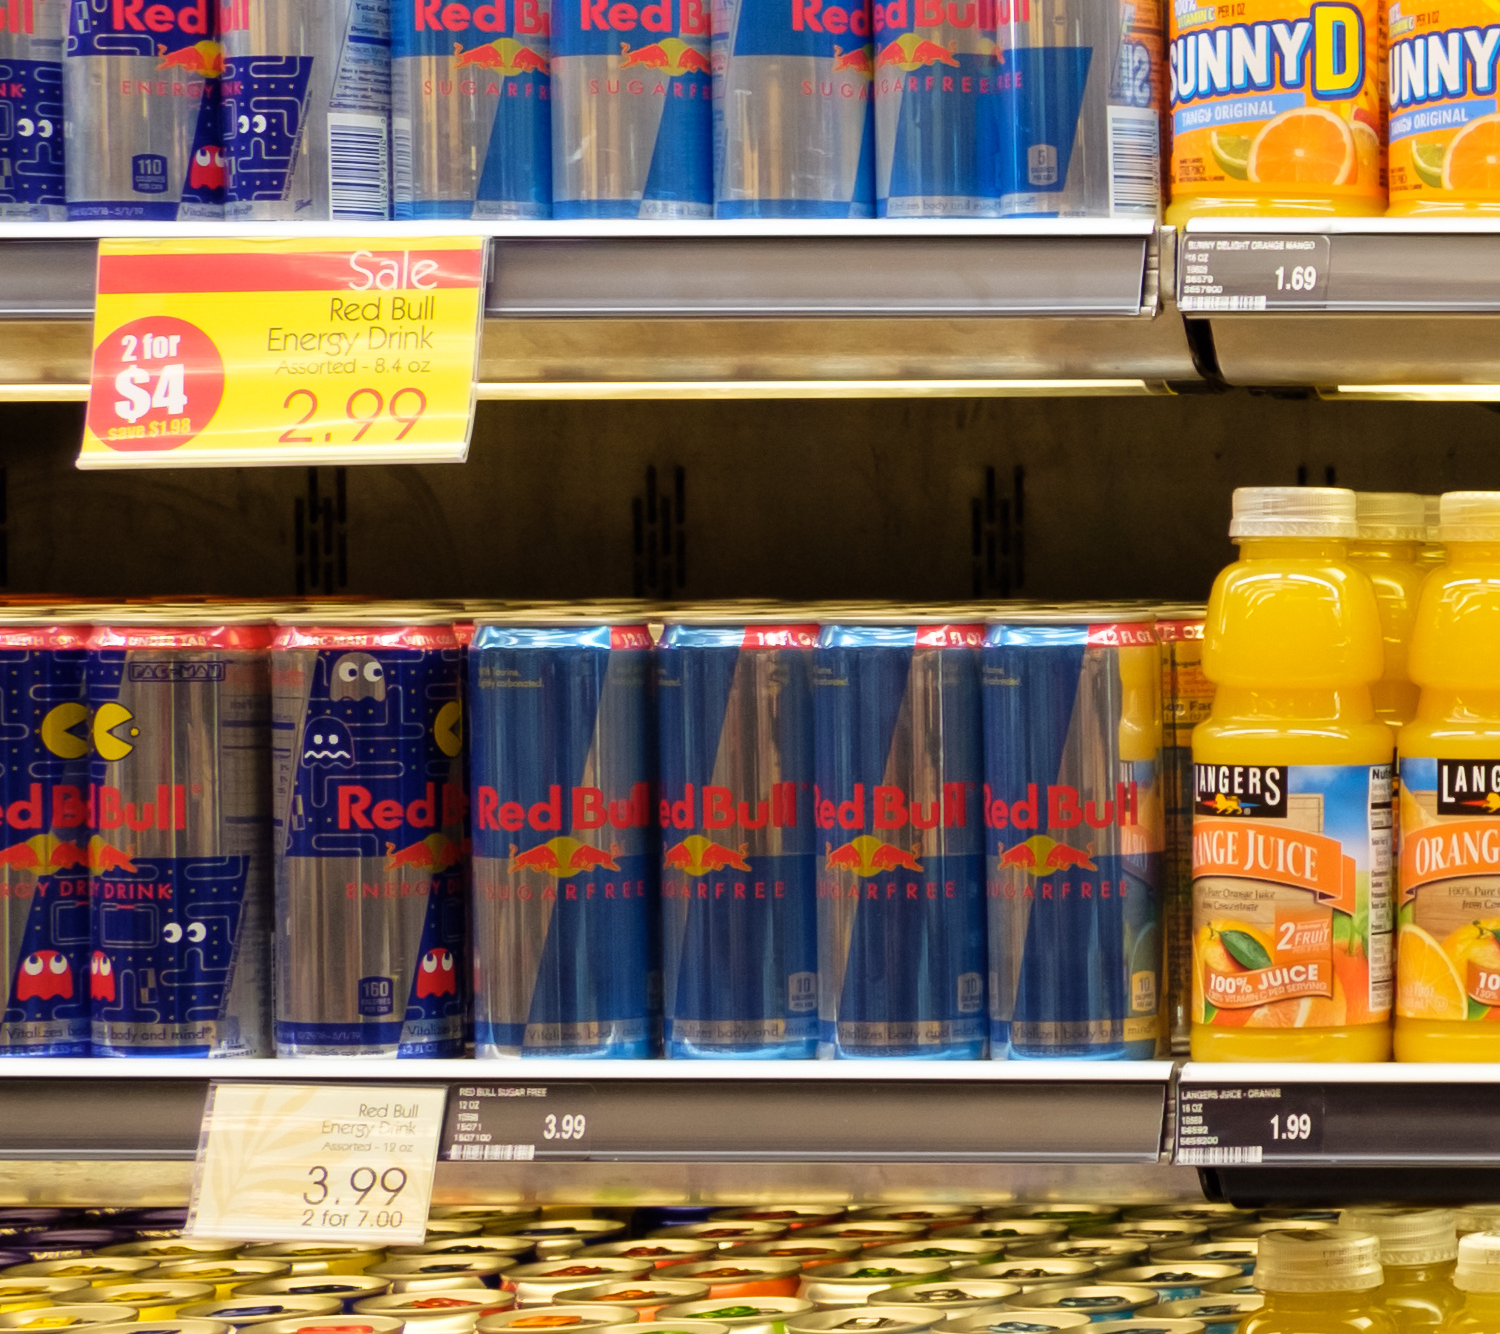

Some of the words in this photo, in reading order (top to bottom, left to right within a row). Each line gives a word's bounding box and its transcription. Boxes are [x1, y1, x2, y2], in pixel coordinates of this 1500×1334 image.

[348, 249, 438, 290] Sale
[1275, 266, 1316, 290] 1.69
[330, 297, 381, 322] Red
[391, 296, 435, 321] Bull
[122, 335, 138, 362] 2
[143, 333, 180, 359] for
[267, 327, 360, 356] Energy
[368, 326, 433, 350] Drink
[276, 358, 356, 375] Assorted
[375, 358, 401, 374] 8.4
[408, 360, 430, 373] oz
[115, 364, 188, 423] $4
[278, 387, 427, 443] 2.99
[108, 423, 146, 440] save
[149, 417, 191, 438] $1.98
[359, 1104, 388, 1118] Red
[394, 1104, 418, 1118] Bull
[322, 1121, 374, 1137] Energy
[380, 1121, 416, 1135] Drink
[543, 1113, 586, 1139] 3.99
[1270, 1114, 1311, 1139] 1.99
[322, 1142, 371, 1152] Assorted
[384, 1143, 395, 1152] 12
[400, 1144, 414, 1153] oz
[303, 1166, 408, 1206] 3.99
[302, 1210, 314, 1227] 2
[322, 1210, 350, 1227] for
[358, 1210, 403, 1228] 7.00
